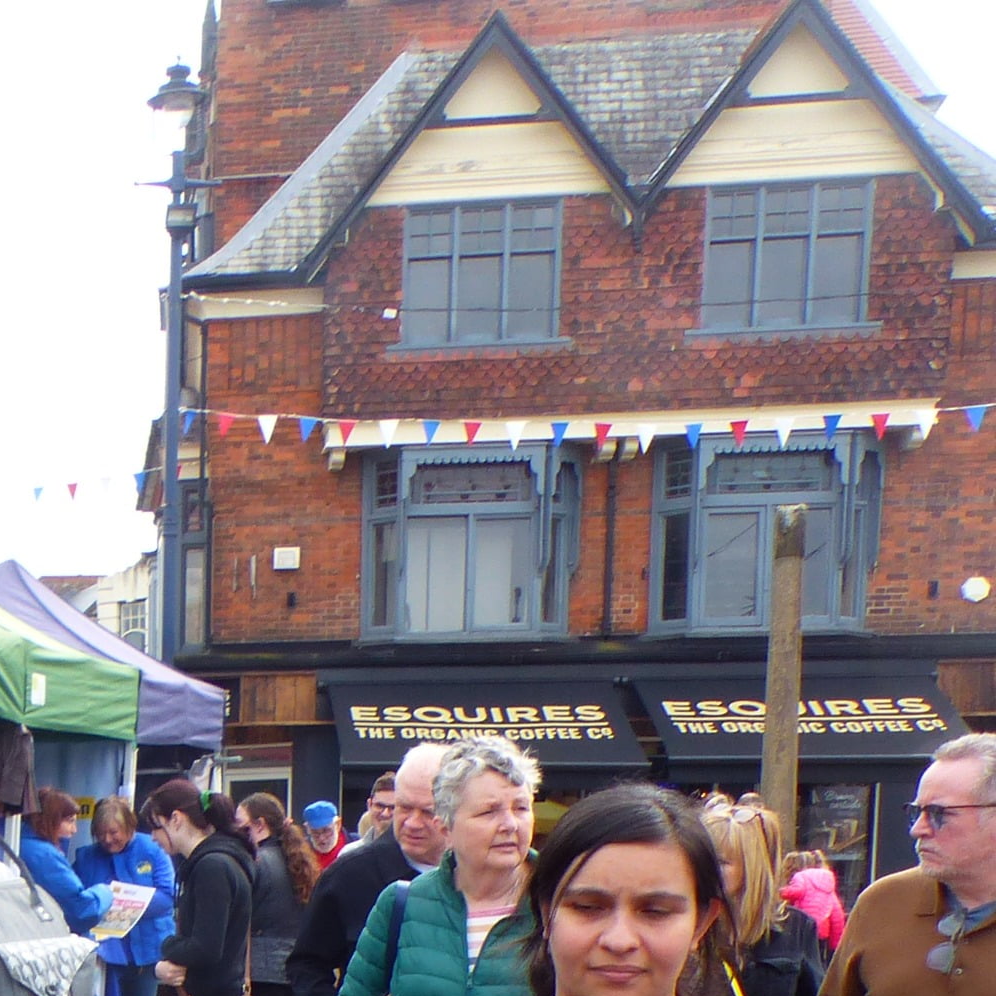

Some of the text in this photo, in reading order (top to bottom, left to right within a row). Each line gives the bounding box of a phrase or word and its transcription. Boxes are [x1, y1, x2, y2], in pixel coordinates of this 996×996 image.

[350, 704, 606, 723] ESQUIRES
[661, 697, 932, 717] ESQIRES
[355, 727, 395, 740] THE
[504, 727, 582, 740] COFFEE
[673, 721, 718, 734] THE
[720, 721, 826, 734] ORGIC
[829, 720, 915, 734] COFFEE
